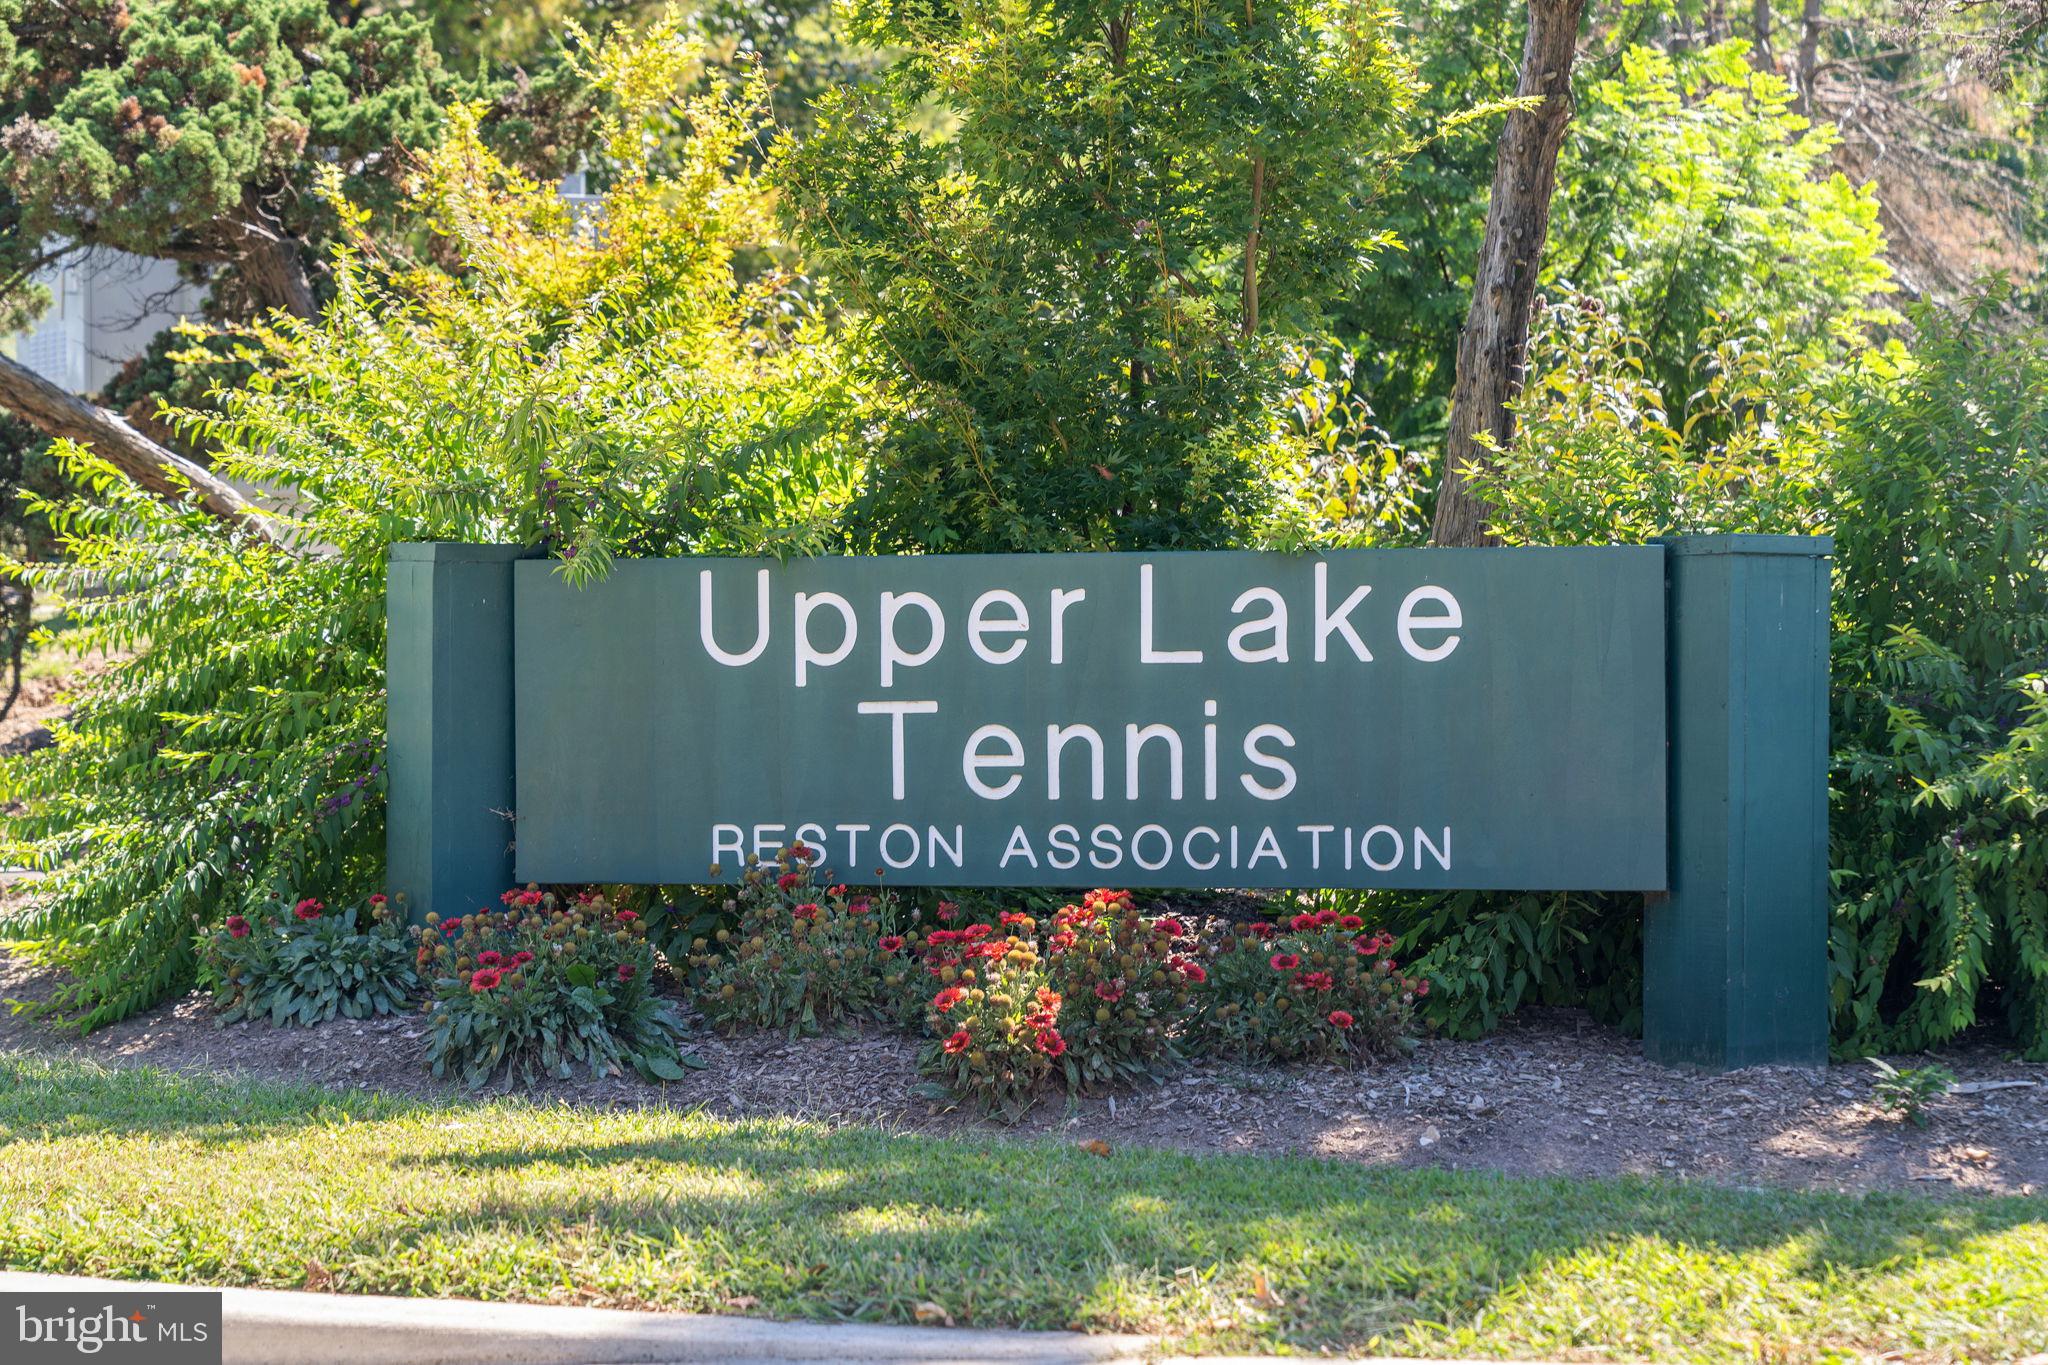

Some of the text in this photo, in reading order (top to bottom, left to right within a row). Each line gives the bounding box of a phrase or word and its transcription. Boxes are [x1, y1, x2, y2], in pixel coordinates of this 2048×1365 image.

[699, 561, 1463, 688] Upper Lake
[857, 699, 1298, 801] Tennis
[711, 823, 1452, 871] RESTON ASSOCIATION
